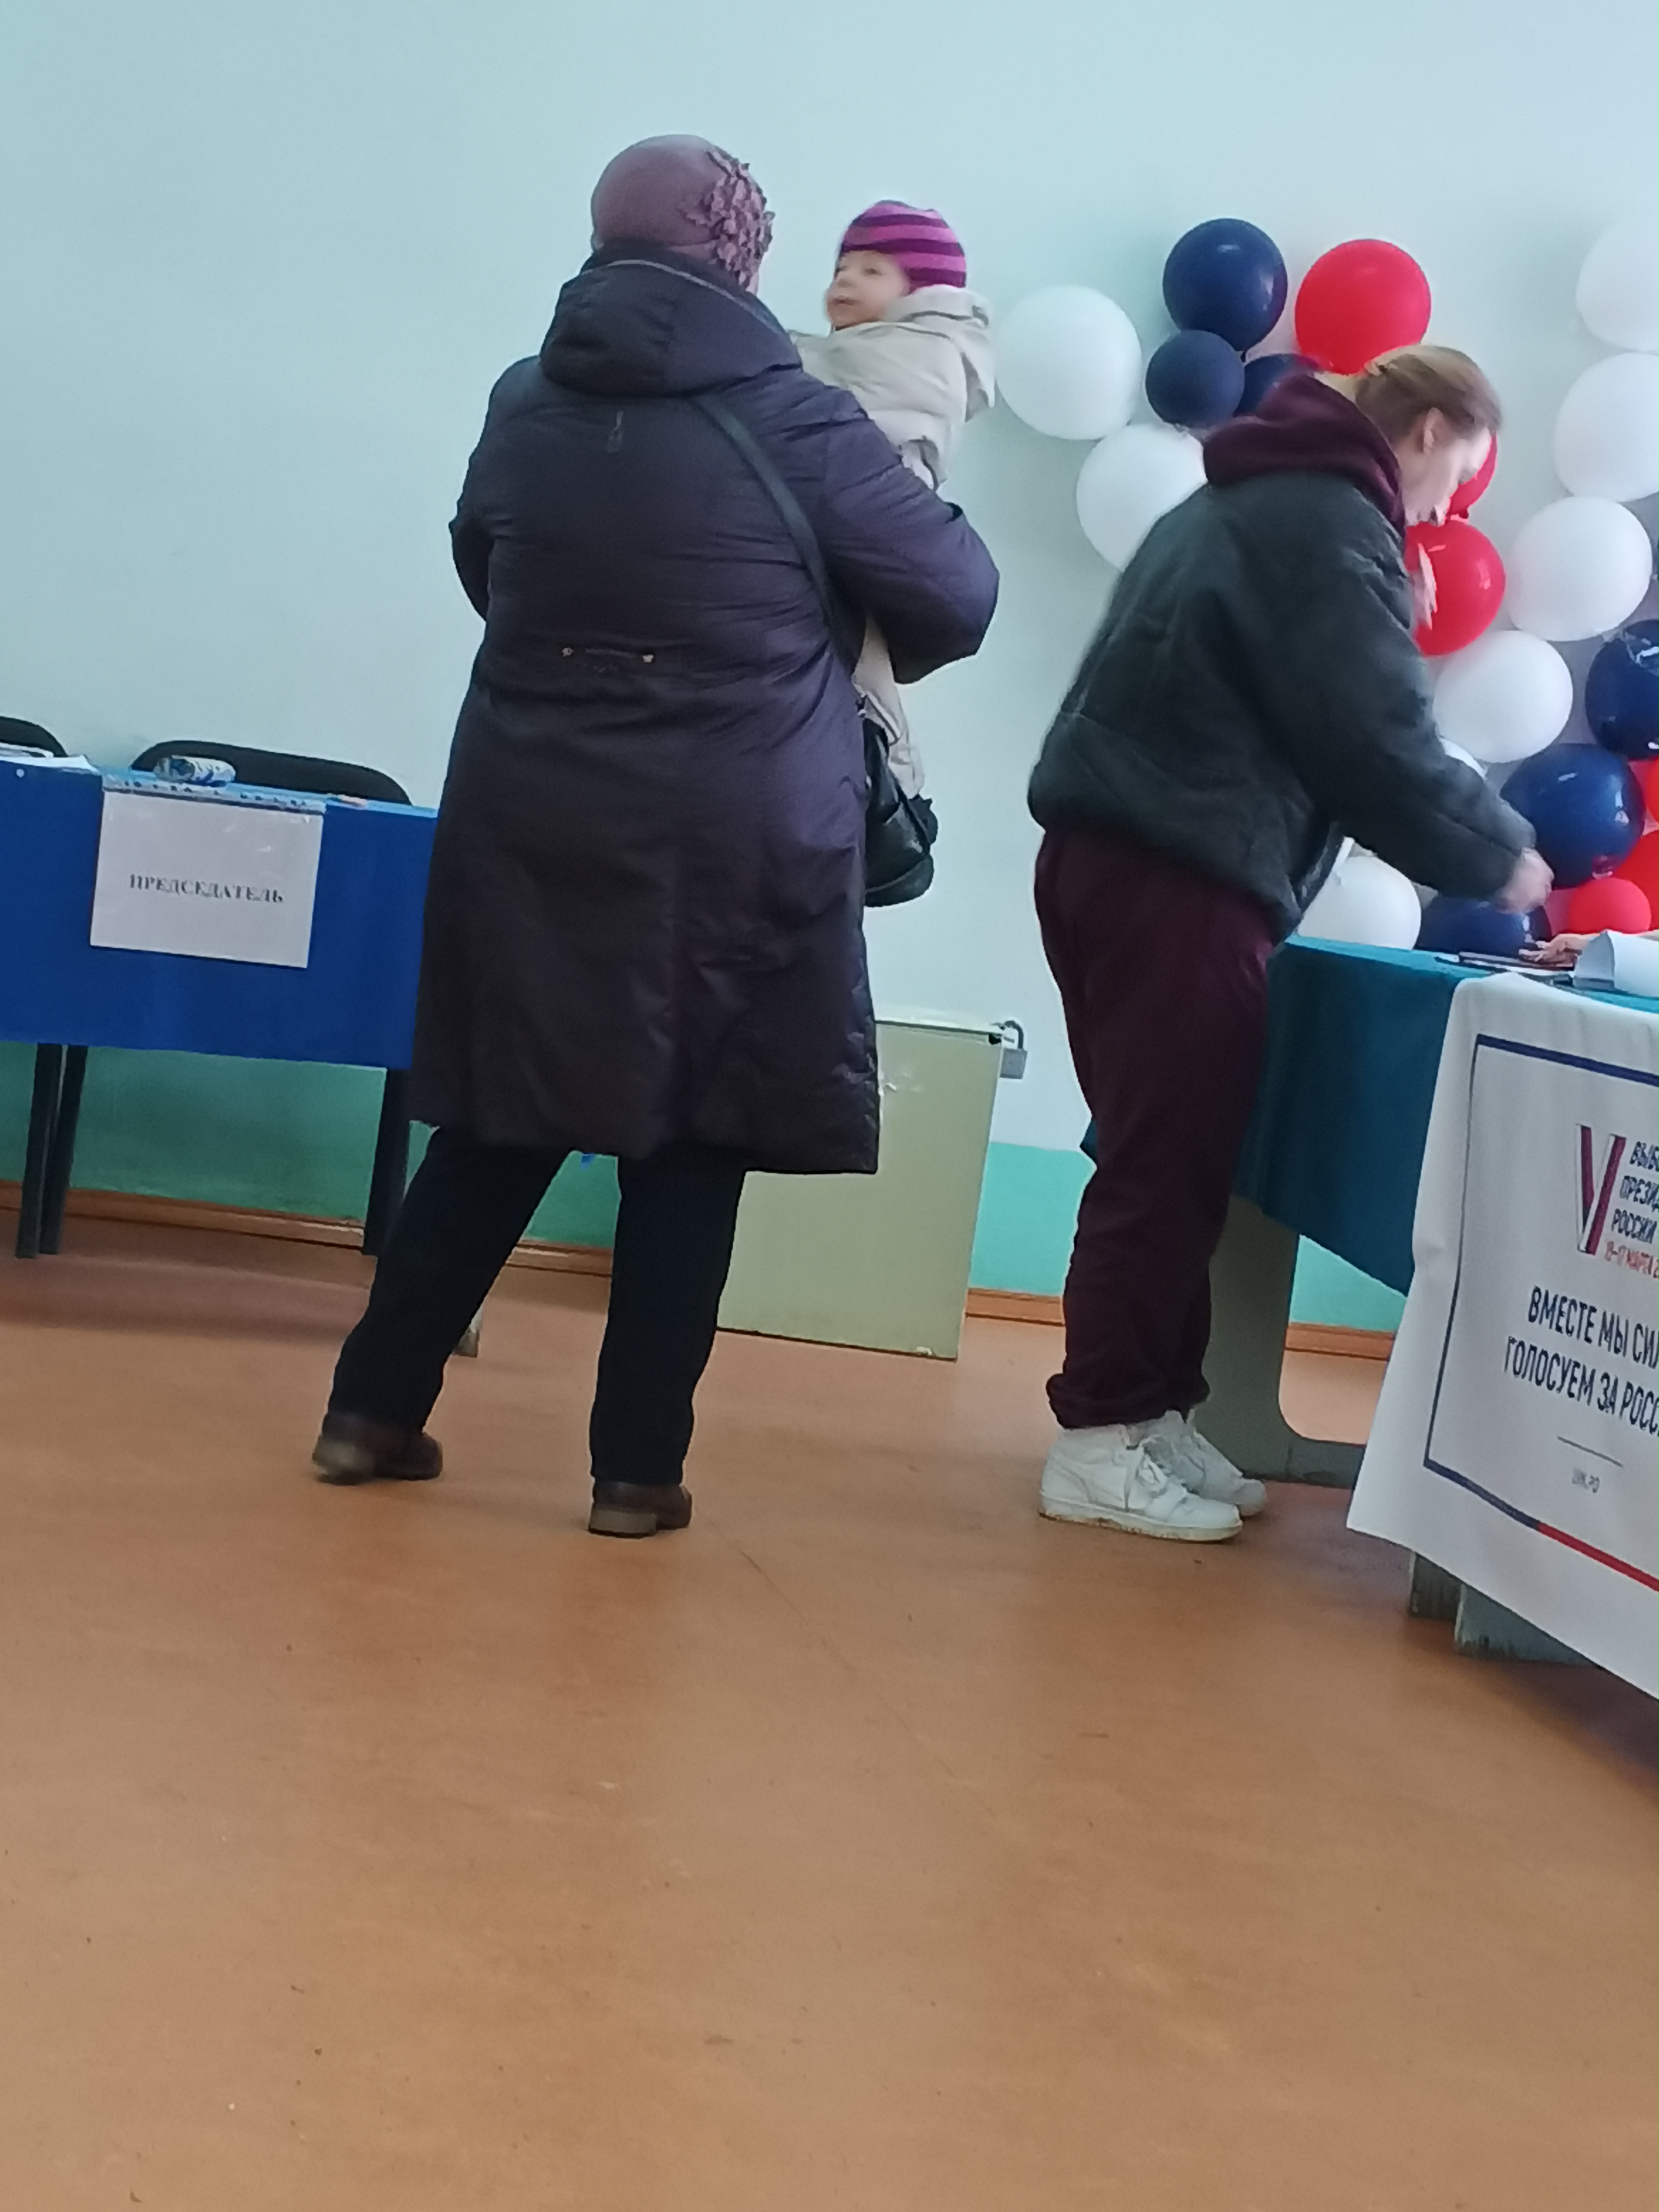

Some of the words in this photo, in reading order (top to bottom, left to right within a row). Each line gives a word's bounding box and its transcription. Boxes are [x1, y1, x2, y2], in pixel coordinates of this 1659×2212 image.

[130, 874, 283, 903] ПРЕДСЕДАТЕЛЬ
[1528, 1285, 1597, 1344] ВМЕСТЕ
[1598, 1309, 1629, 1357] МЫ
[1504, 1335, 1596, 1406] ГОЛОСУЕМ
[1597, 1372, 1619, 1415] ЗА
[1619, 1381, 1659, 1437] РОСС
